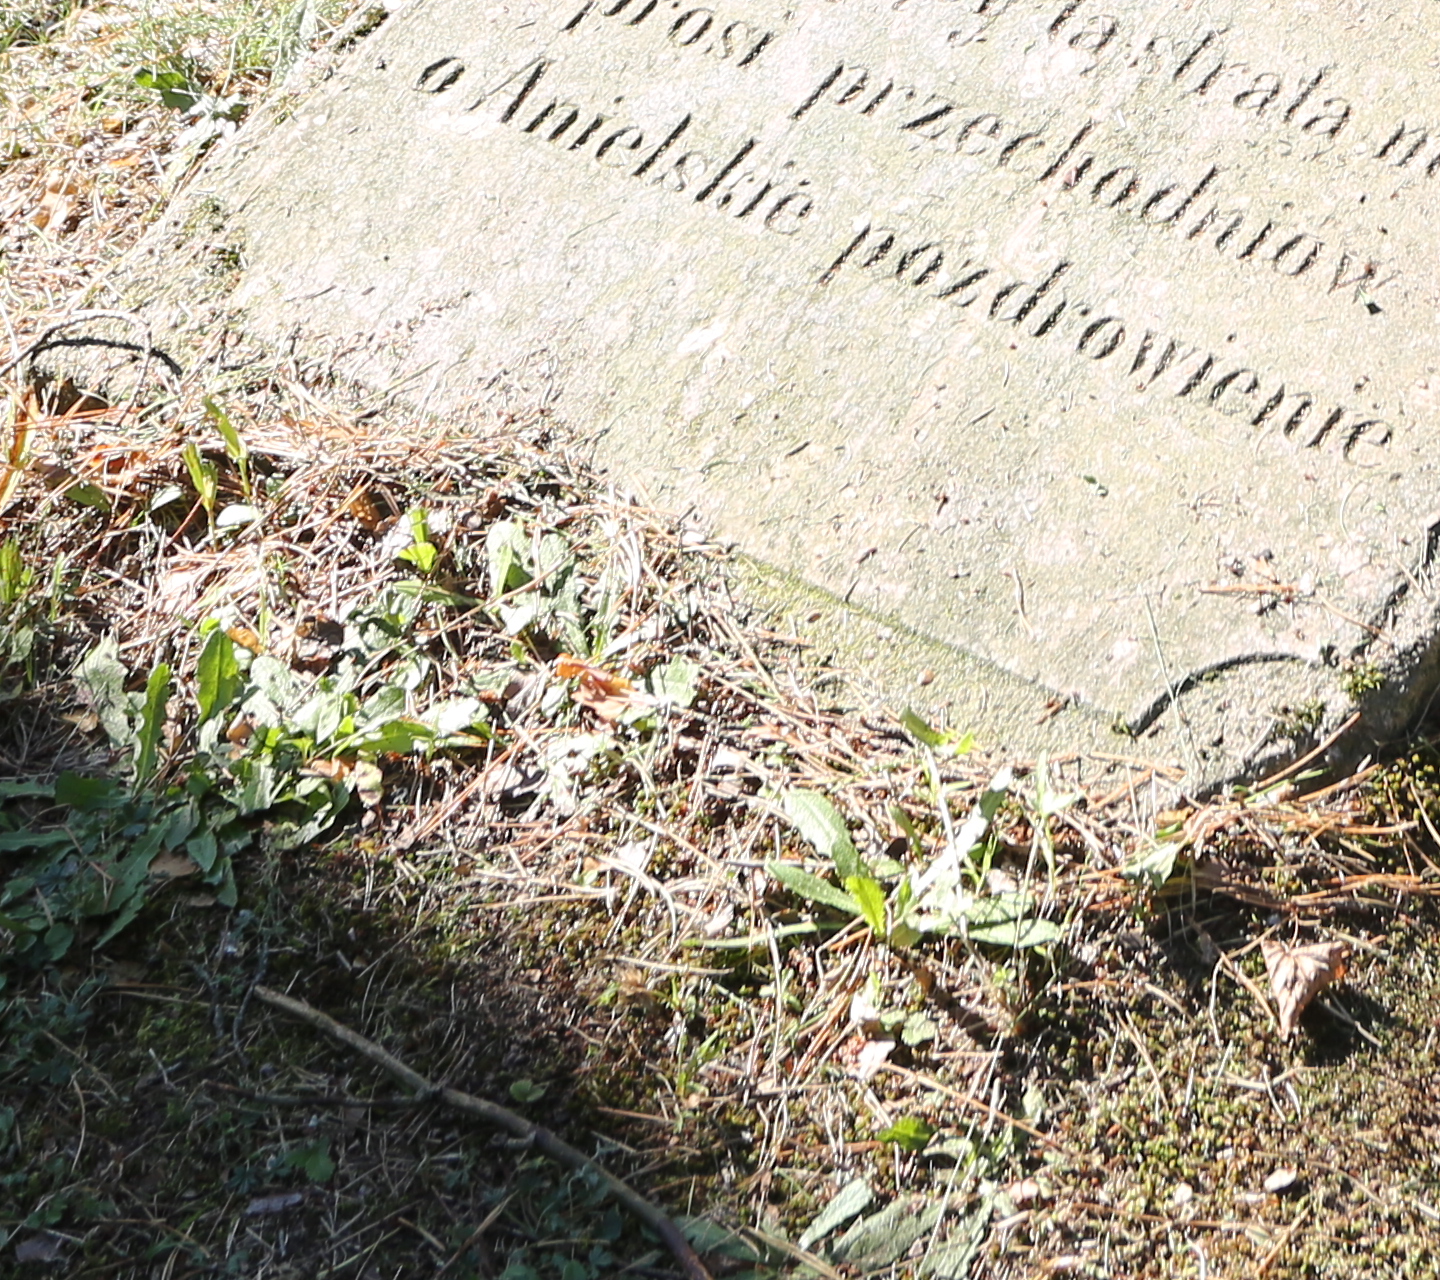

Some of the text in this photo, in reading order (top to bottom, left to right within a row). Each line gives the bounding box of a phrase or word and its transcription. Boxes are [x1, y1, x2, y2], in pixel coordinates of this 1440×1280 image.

[412, 52, 1394, 468] o Anielskie pozdrowienie
